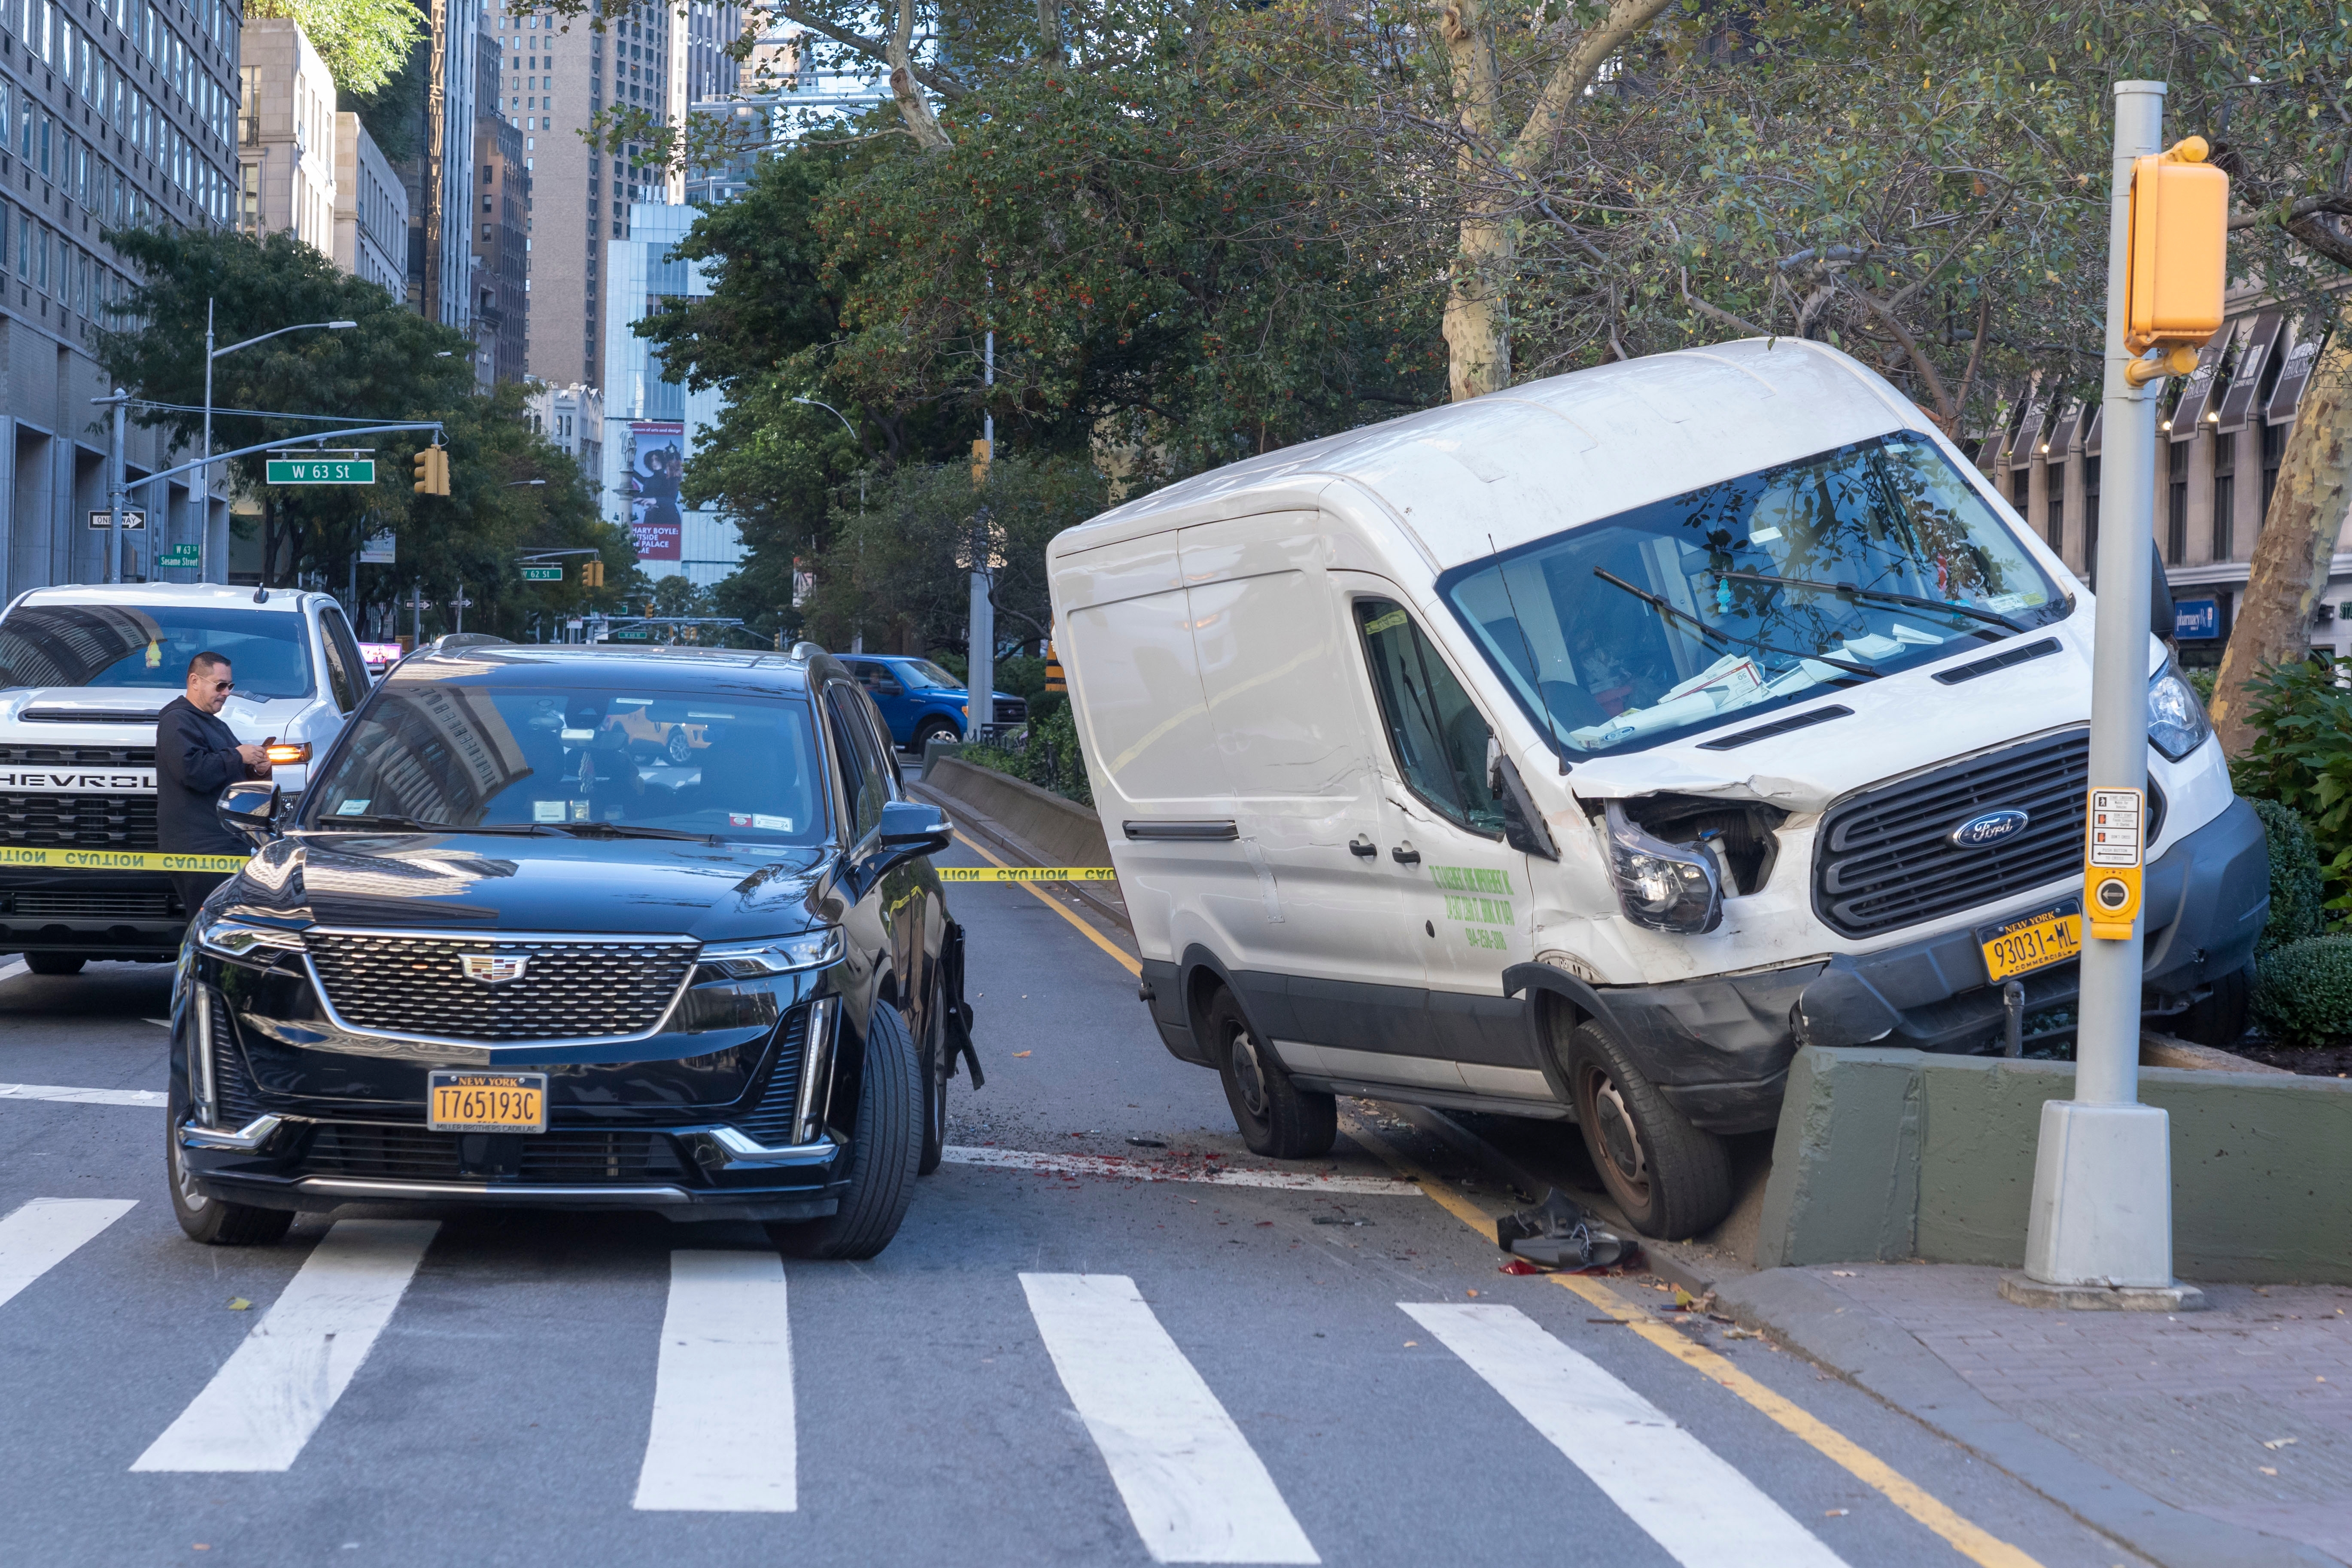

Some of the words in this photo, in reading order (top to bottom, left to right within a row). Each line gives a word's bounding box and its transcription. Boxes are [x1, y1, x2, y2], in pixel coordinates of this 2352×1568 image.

[292, 465, 305, 478] W
[313, 465, 329, 478] 63
[336, 465, 349, 478] St
[176, 545, 181, 554] W
[183, 545, 191, 555] 63
[161, 556, 180, 566] Sesame
[182, 557, 198, 566] Street
[2177, 609, 2200, 631] pharmacy
[1738, 672, 1747, 681] 50
[0, 774, 157, 788] HEVROL
[1972, 817, 2013, 842] Ford
[2004, 920, 2027, 934] NEW
[2029, 911, 2056, 926] YORK
[2015, 950, 2067, 972] COMMERCIAL
[458, 1077, 485, 1086] NEW
[489, 1078, 518, 1087] YORK
[440, 1091, 534, 1120] T765193C
